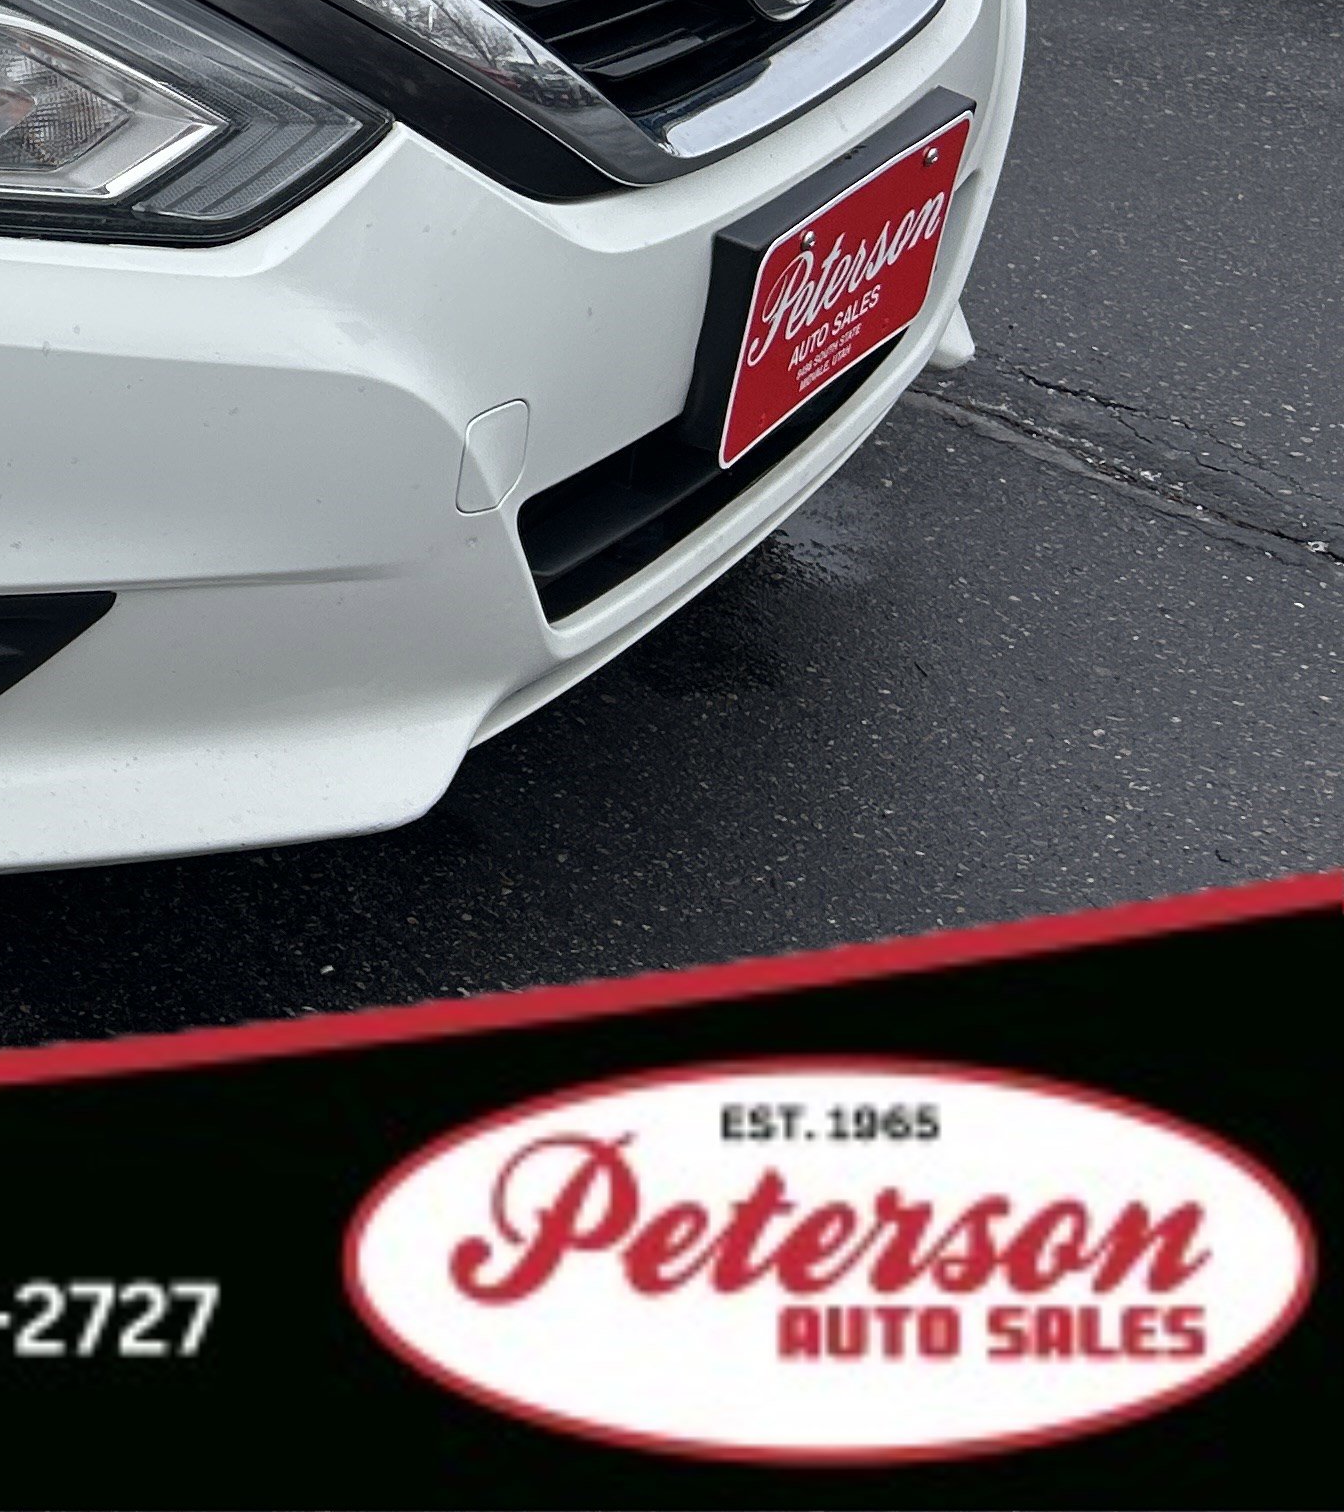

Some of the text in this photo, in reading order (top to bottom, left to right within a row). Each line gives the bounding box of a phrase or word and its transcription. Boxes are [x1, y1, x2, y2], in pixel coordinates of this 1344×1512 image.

[748, 191, 945, 367] Peterson
[788, 284, 881, 371] AUTO SALES
